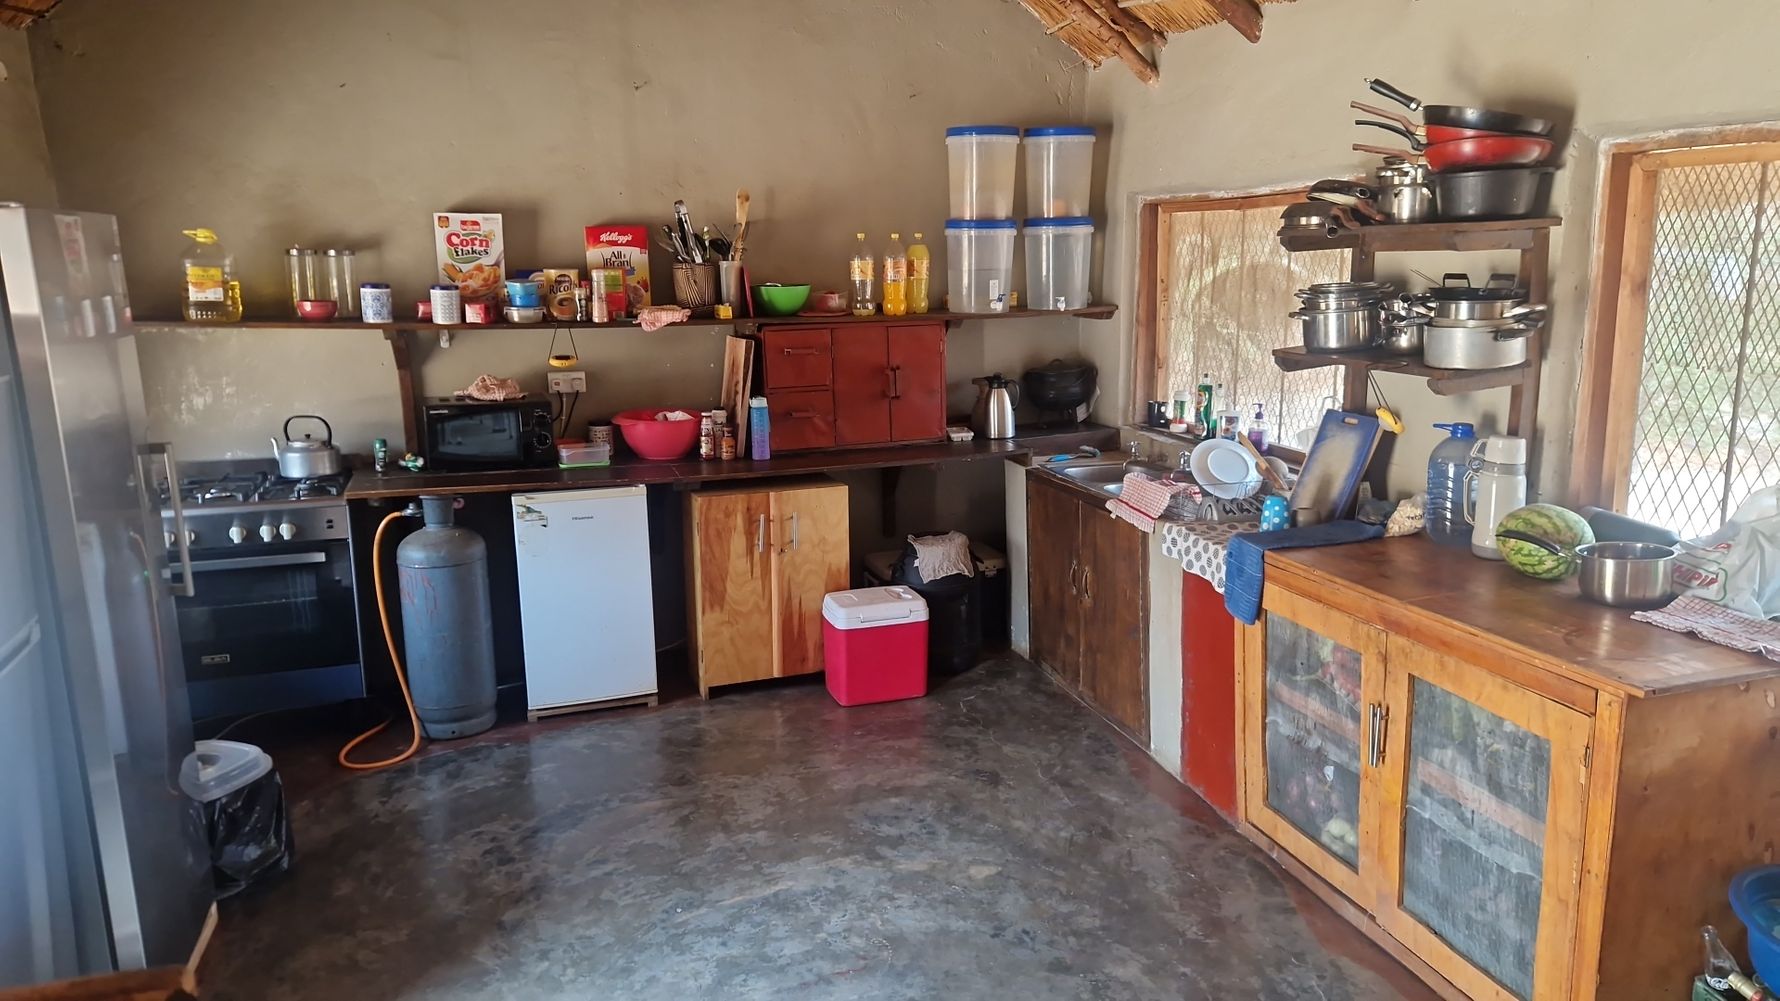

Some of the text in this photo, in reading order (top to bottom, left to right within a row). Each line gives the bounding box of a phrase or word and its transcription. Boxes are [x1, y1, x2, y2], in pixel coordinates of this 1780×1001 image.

[446, 232, 490, 248] Corn
[600, 231, 632, 244] Kellogg's
[453, 247, 489, 257] flakes
[610, 250, 623, 260] All
[605, 257, 629, 267] Bran
